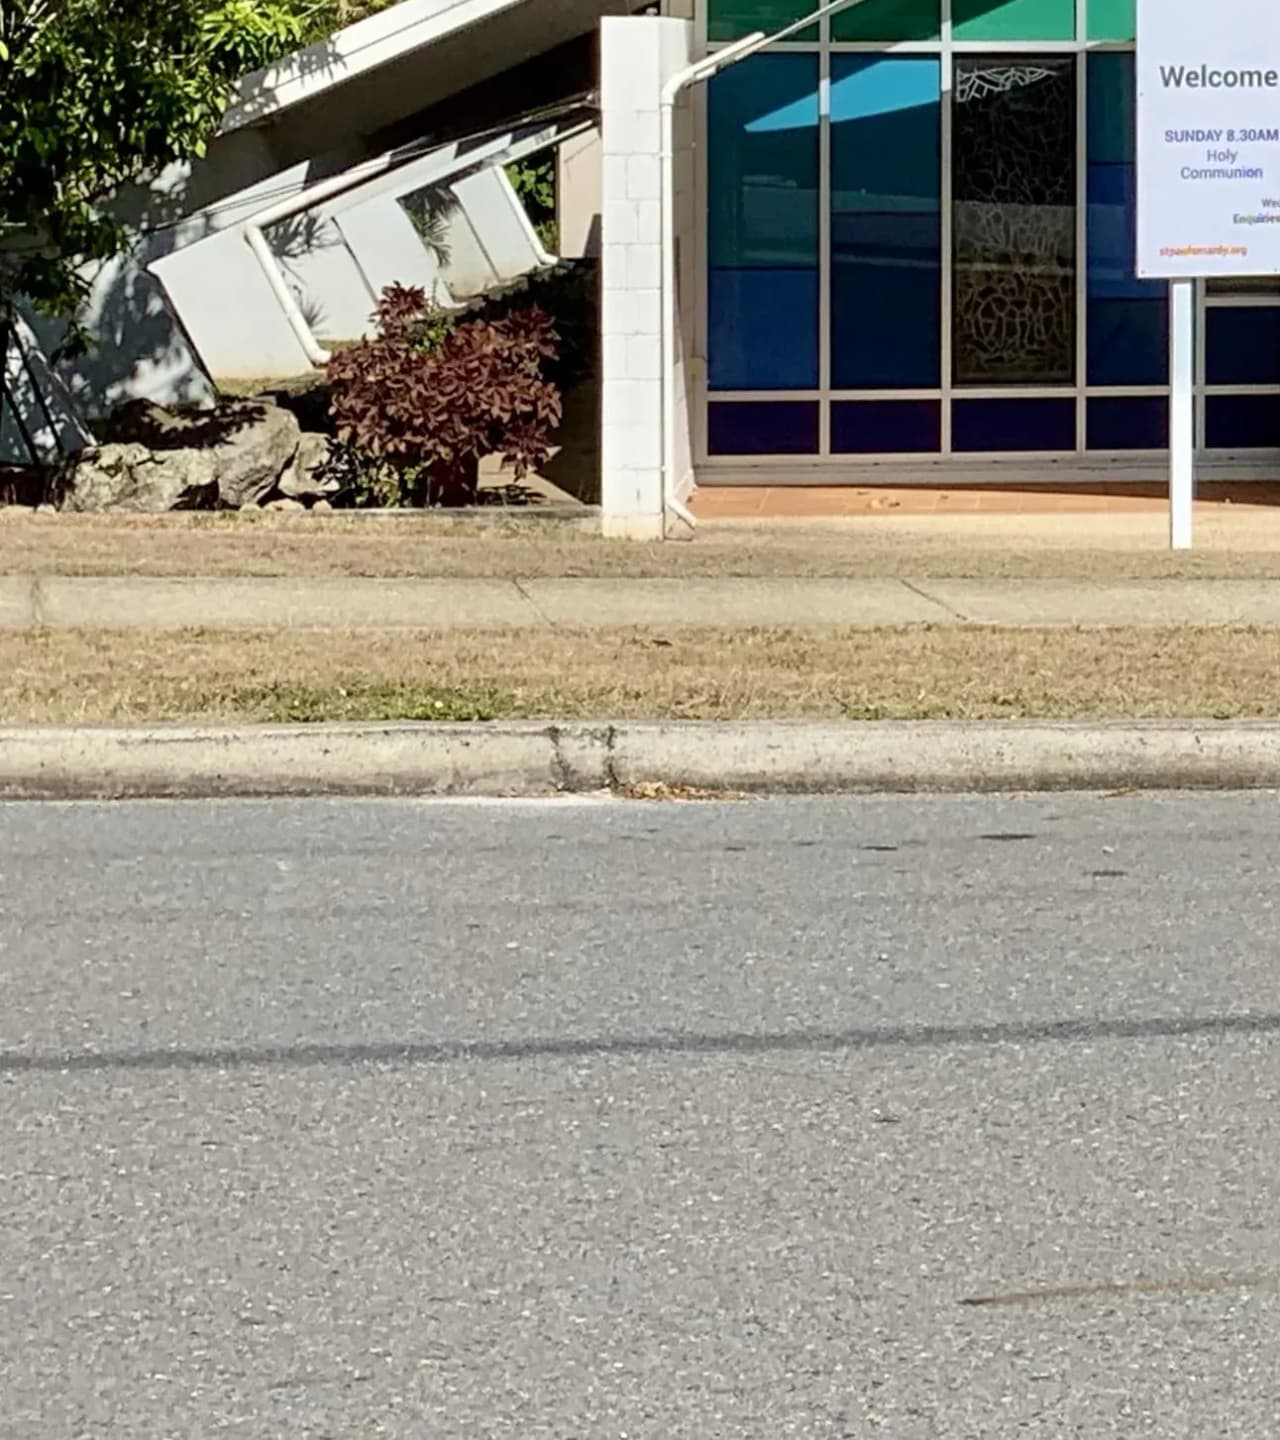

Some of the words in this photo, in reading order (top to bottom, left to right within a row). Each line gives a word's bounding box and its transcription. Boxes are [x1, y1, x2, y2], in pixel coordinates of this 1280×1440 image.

[1160, 64, 1278, 87] Welcome
[1165, 130, 1223, 142] SUNDAY
[1227, 129, 1279, 142] 8.30AM
[1207, 149, 1238, 164] Holy
[1181, 167, 1263, 179] Communion
